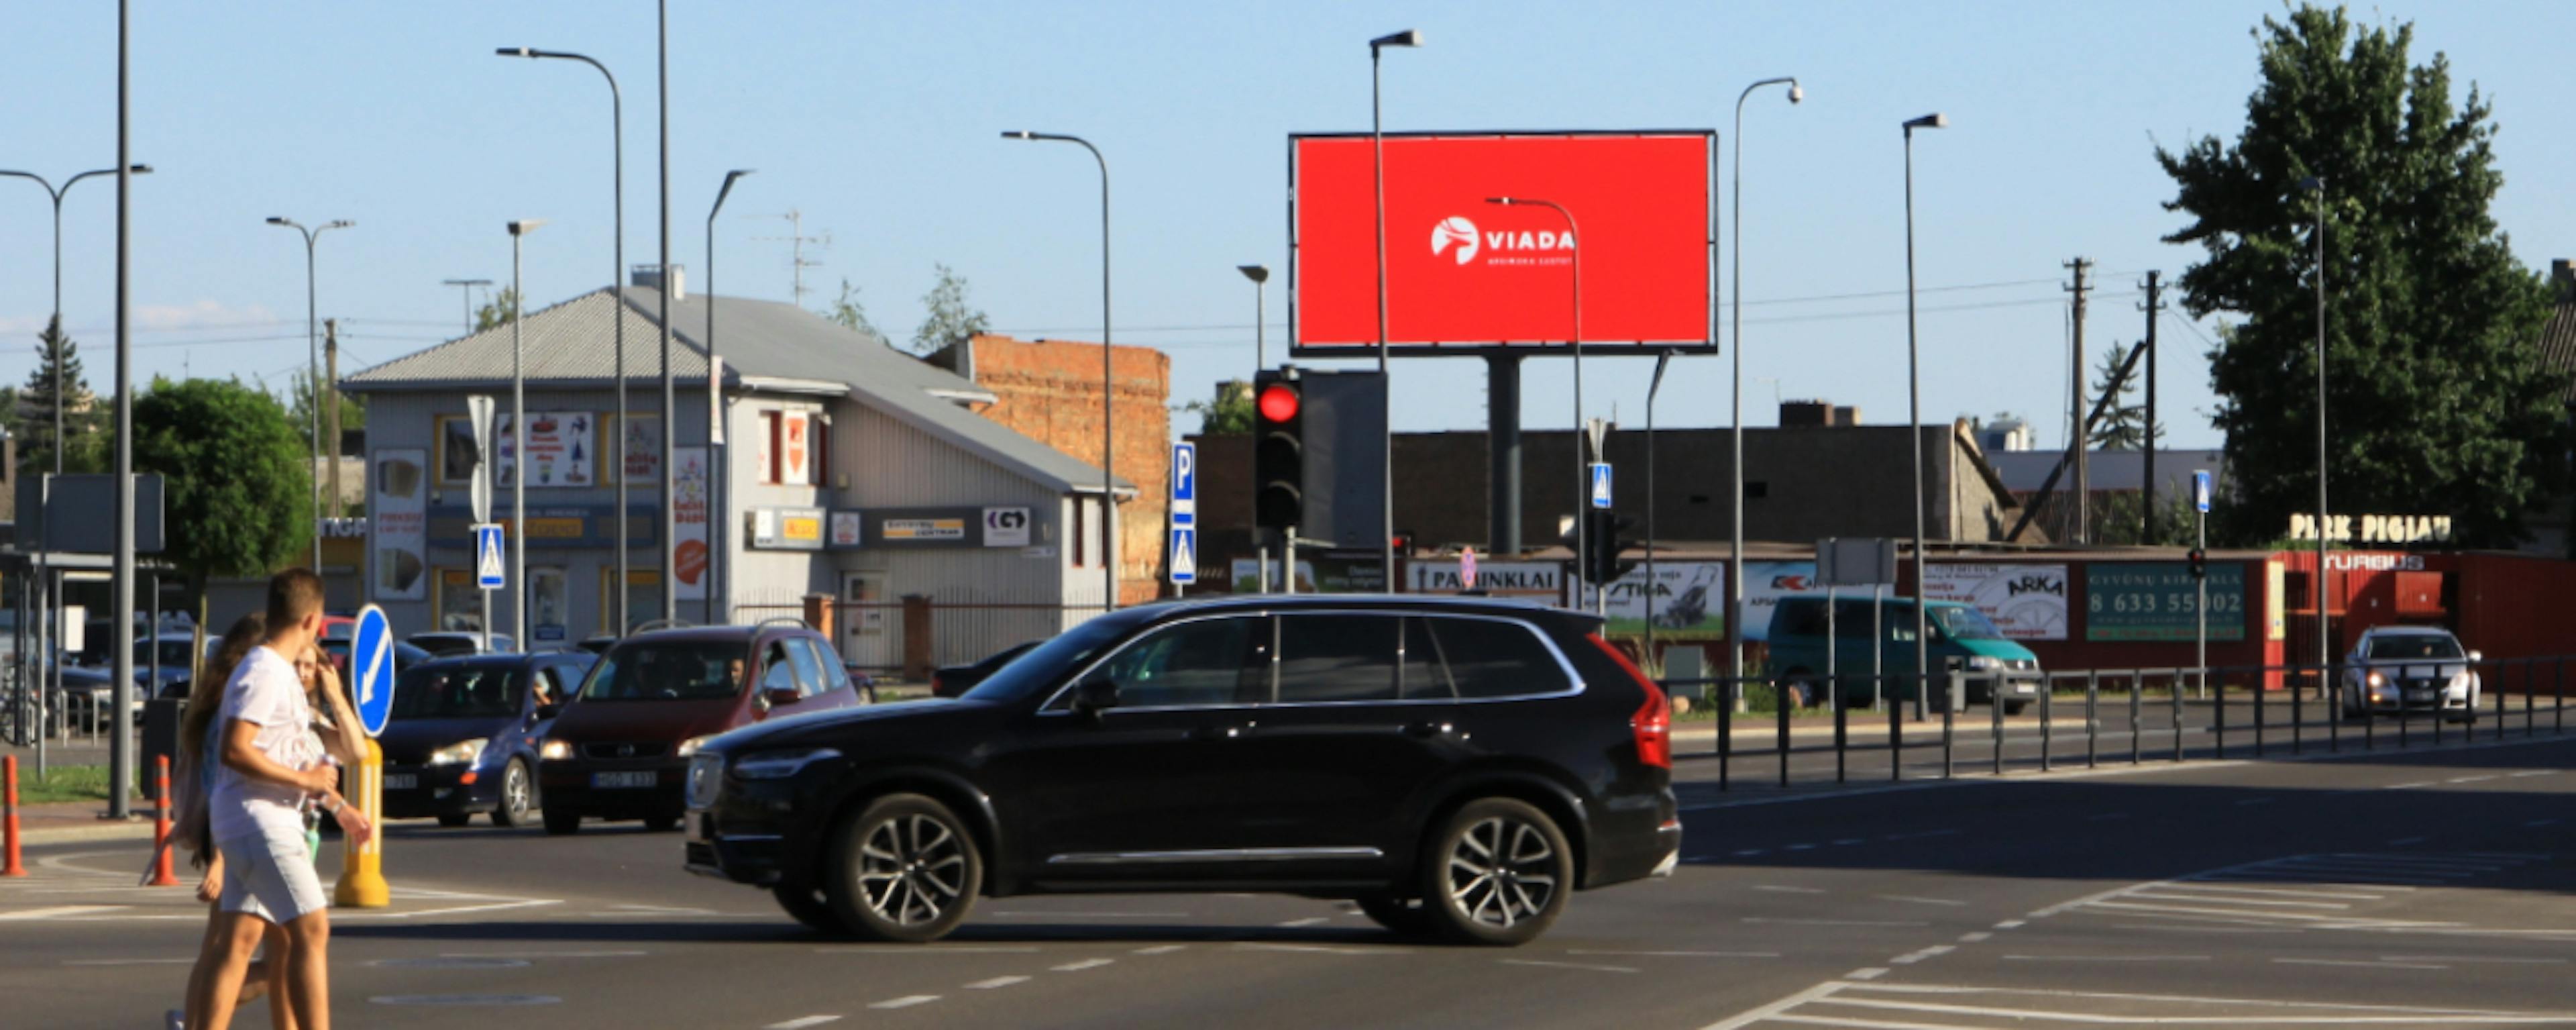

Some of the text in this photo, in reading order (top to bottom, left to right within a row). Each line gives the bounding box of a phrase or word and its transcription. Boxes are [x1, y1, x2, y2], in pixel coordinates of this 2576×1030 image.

[1486, 231, 1576, 250] VIADA
[1177, 448, 1191, 490] P
[2361, 515, 2452, 542] PIGIAU
[1433, 572, 1554, 588] PAINKLAI
[2008, 576, 2063, 597] ARKA
[2162, 574, 2241, 586] KIRKLA
[2090, 593, 2103, 612] 8
[2114, 593, 2156, 612] 633
